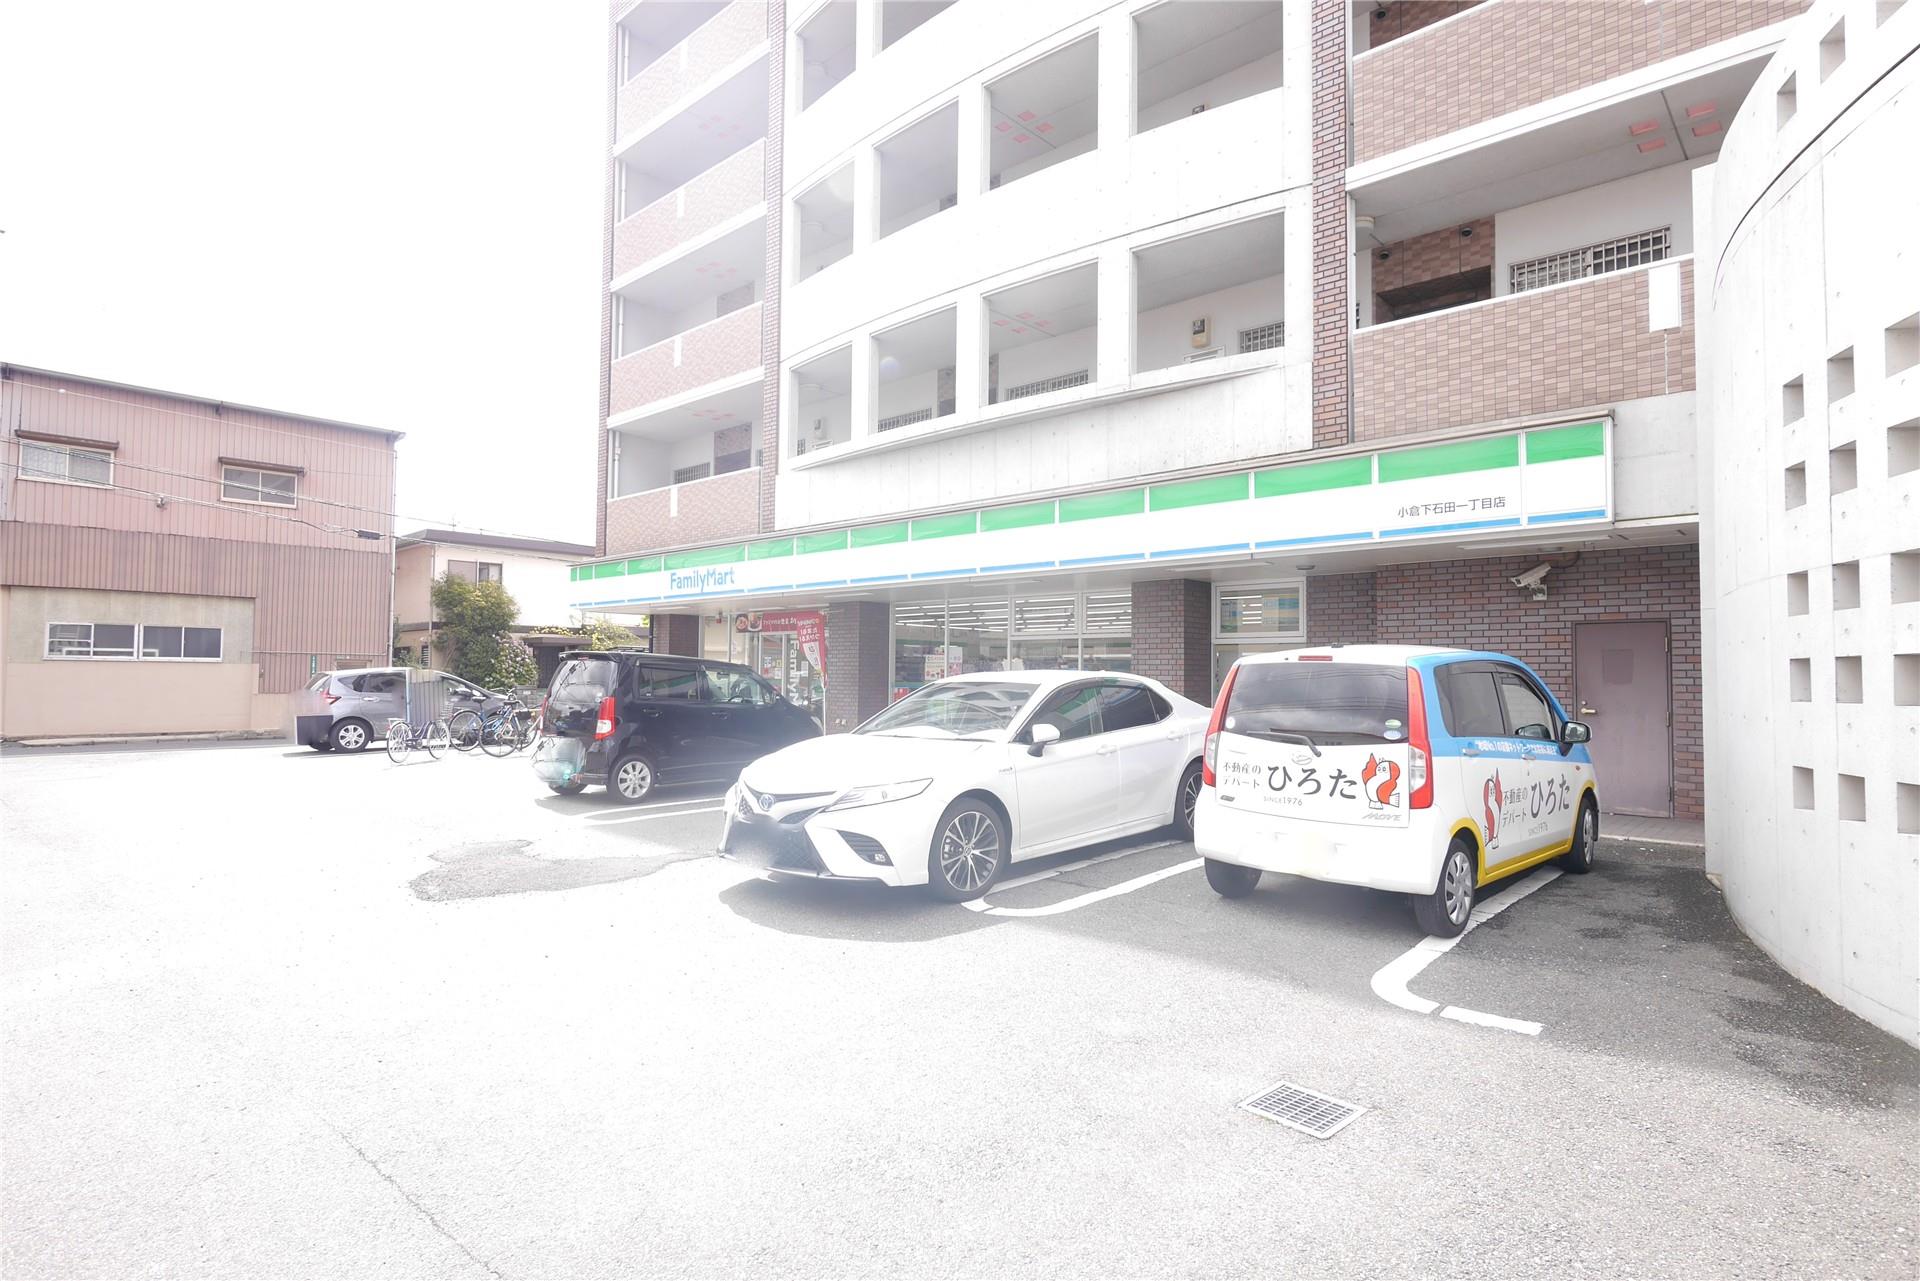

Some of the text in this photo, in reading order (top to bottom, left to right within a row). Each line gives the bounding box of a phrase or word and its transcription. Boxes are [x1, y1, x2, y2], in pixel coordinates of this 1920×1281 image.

[1398, 496, 1506, 518] 小倉下石田一丁目店
[670, 567, 735, 592] FamilyMart
[1223, 762, 1262, 775] 不動産の
[1267, 766, 1358, 800] ひろた
[1503, 786, 1528, 806] 不動産の
[1530, 773, 1570, 819] ひろた
